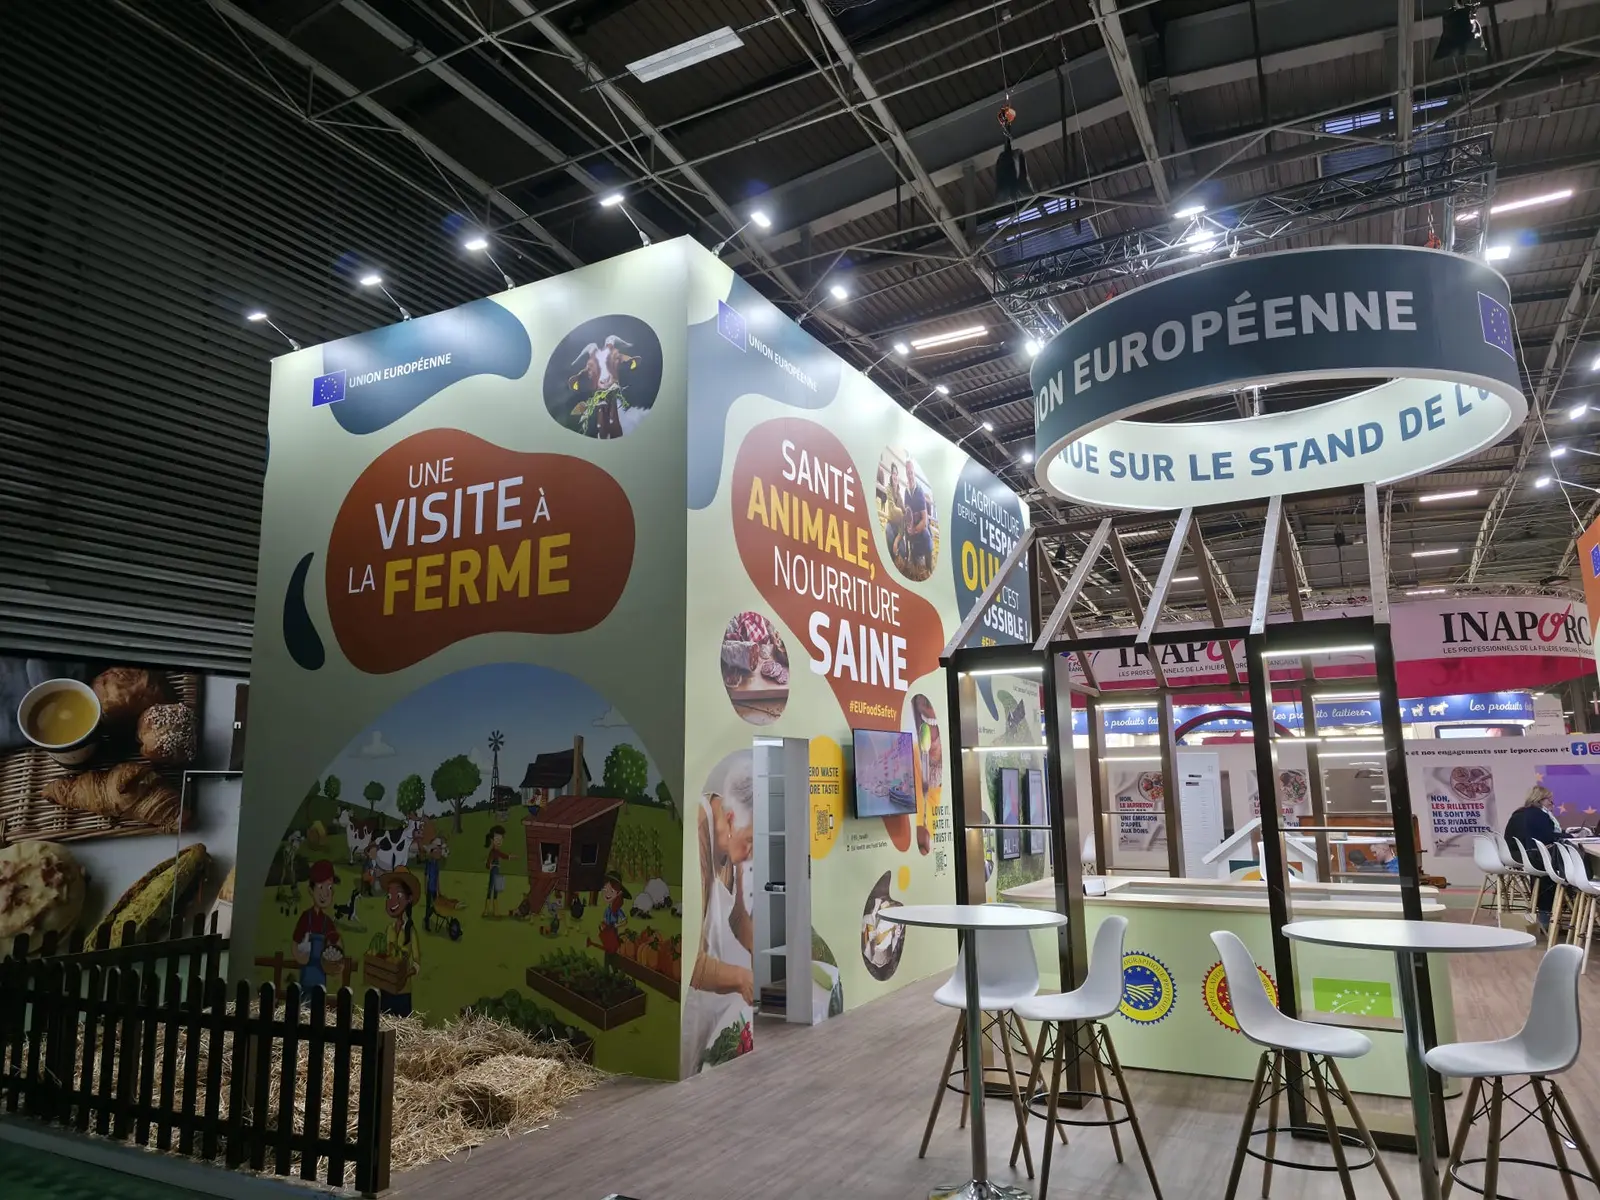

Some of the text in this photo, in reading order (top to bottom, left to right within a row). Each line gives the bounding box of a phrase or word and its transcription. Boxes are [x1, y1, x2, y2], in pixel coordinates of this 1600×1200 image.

[1073, 290, 1417, 395] EUROPÉENNE
[348, 352, 452, 388] UNION EUROPÉENNE
[748, 333, 818, 392] UNION EUROPÉENNE
[1109, 449, 1176, 482] SUR
[1189, 450, 1235, 482] LE
[1250, 421, 1384, 477] STAND
[1399, 393, 1446, 442] DE
[408, 456, 454, 489] UNE
[781, 438, 856, 513] SANTÉ
[375, 476, 552, 550] VISITE À
[957, 503, 978, 525] DEPUIS
[963, 480, 1020, 538] L'AGRICULTURE
[746, 476, 876, 581] ANIMALE,
[348, 532, 571, 616] LA FERME
[773, 545, 901, 627] NOURRITURE
[1002, 585, 1020, 611] C'EST
[976, 597, 1025, 641] OSSIBLE
[1439, 603, 1592, 646] INAPORC
[808, 609, 908, 692] SAINE
[1458, 644, 1520, 653] PROFESSIONNELS
[1131, 665, 1184, 676] PROFESNNELS
[1185, 665, 1195, 673] DE
[1195, 664, 1204, 672] LA
[849, 701, 897, 721] #EUFoodSafety
[1332, 708, 1372, 718] laitiers
[1488, 701, 1523, 713] produits
[1111, 716, 1145, 729] produits
[1437, 748, 1492, 757] engagements
[820, 767, 839, 778] WASTE
[822, 784, 840, 795] TASTE!
[1431, 795, 1450, 803] NON,
[932, 806, 944, 816] LOVE
[932, 819, 944, 830] HATE
[933, 833, 947, 843] TRUST
